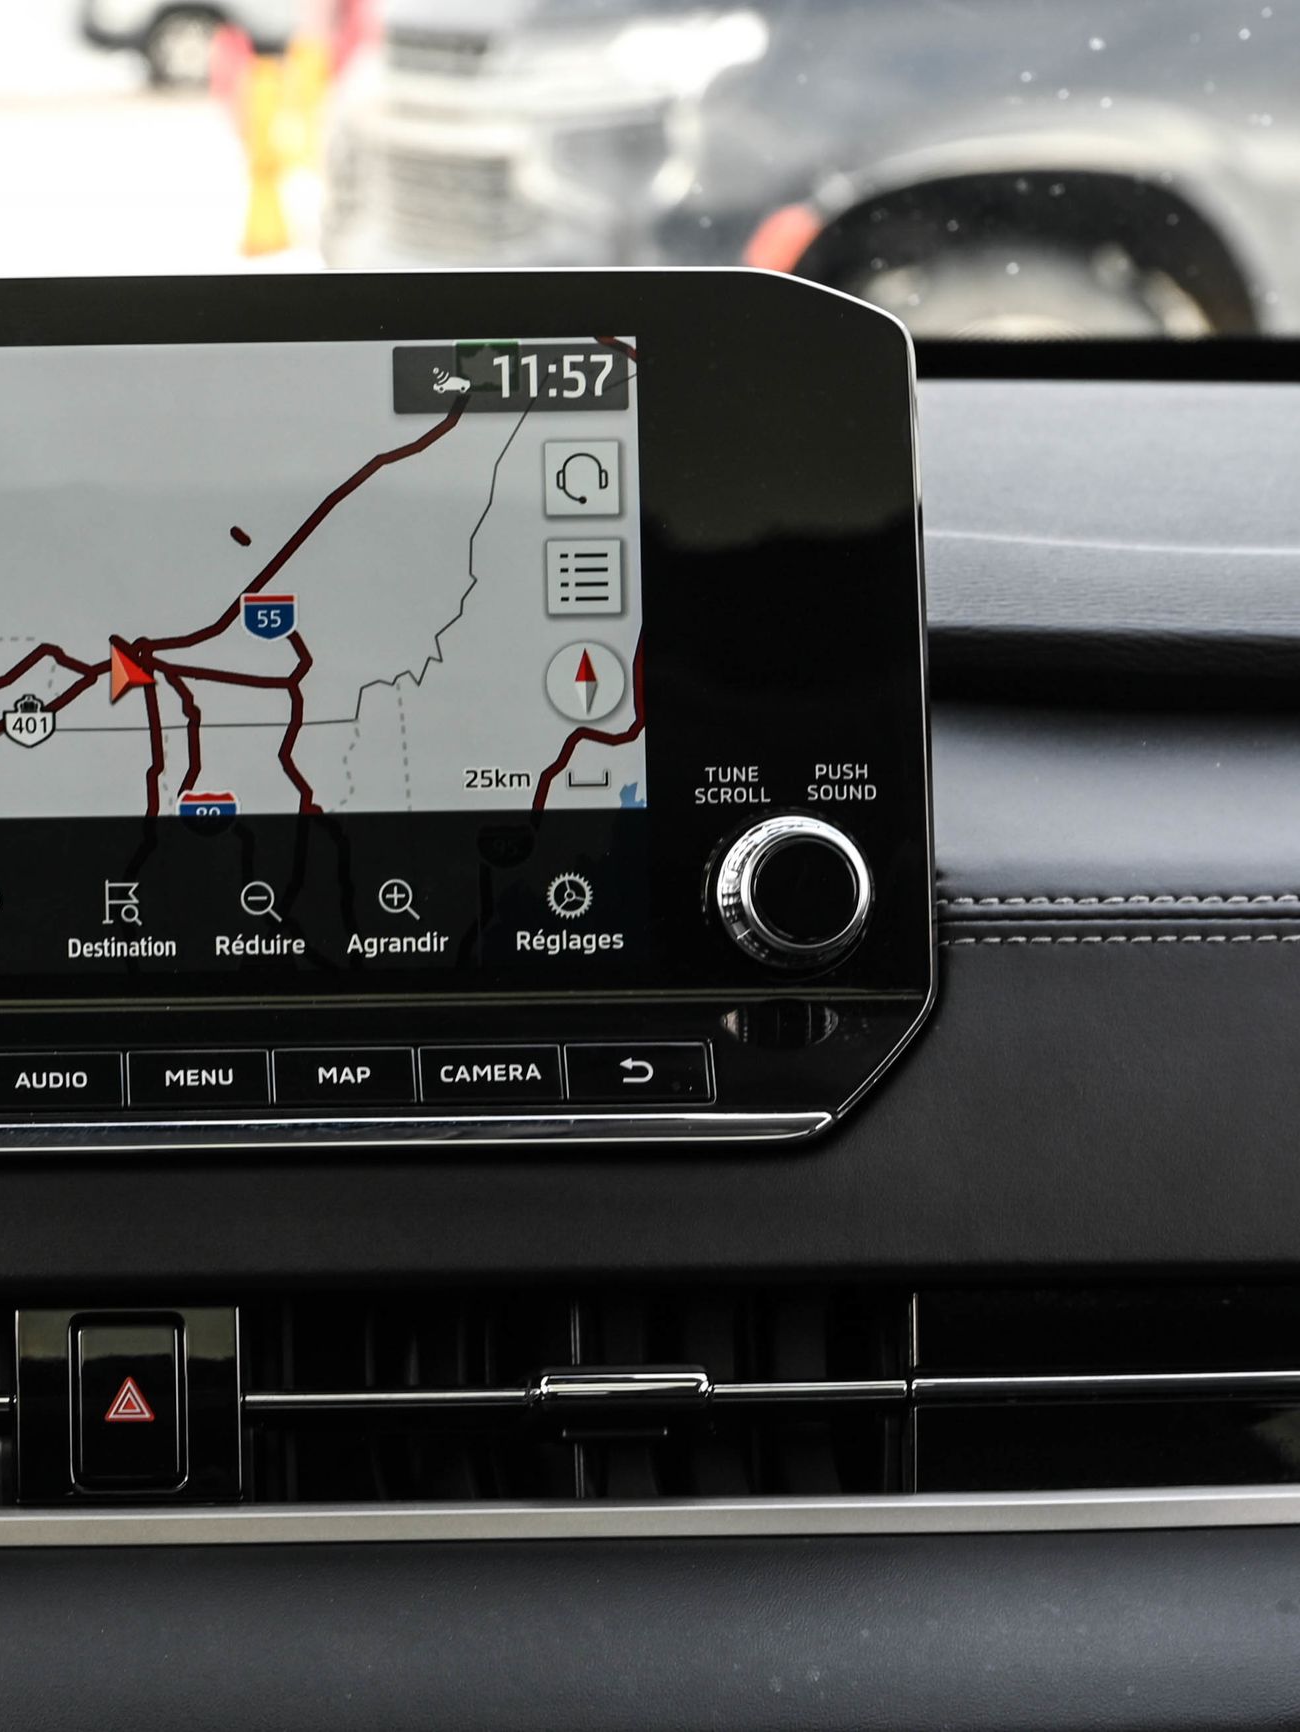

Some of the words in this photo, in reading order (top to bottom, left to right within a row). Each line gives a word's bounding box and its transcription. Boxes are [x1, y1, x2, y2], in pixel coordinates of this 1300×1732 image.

[492, 353, 614, 400] 11:57
[256, 608, 283, 629] 55
[8, 715, 52, 740] 401
[465, 768, 532, 790] 25km
[704, 766, 760, 784] TUNE
[815, 763, 869, 780] PUSH
[694, 785, 772, 804] SCROLL
[806, 784, 878, 801] SOUND
[67, 936, 178, 960] Destination
[214, 932, 307, 956] Réduire
[346, 930, 450, 958] Agrandir
[515, 927, 625, 956] Réglages
[14, 1070, 89, 1090] AUDIO
[164, 1067, 234, 1088] MENU
[317, 1065, 372, 1085] MAP
[439, 1062, 543, 1084] CAMERA
